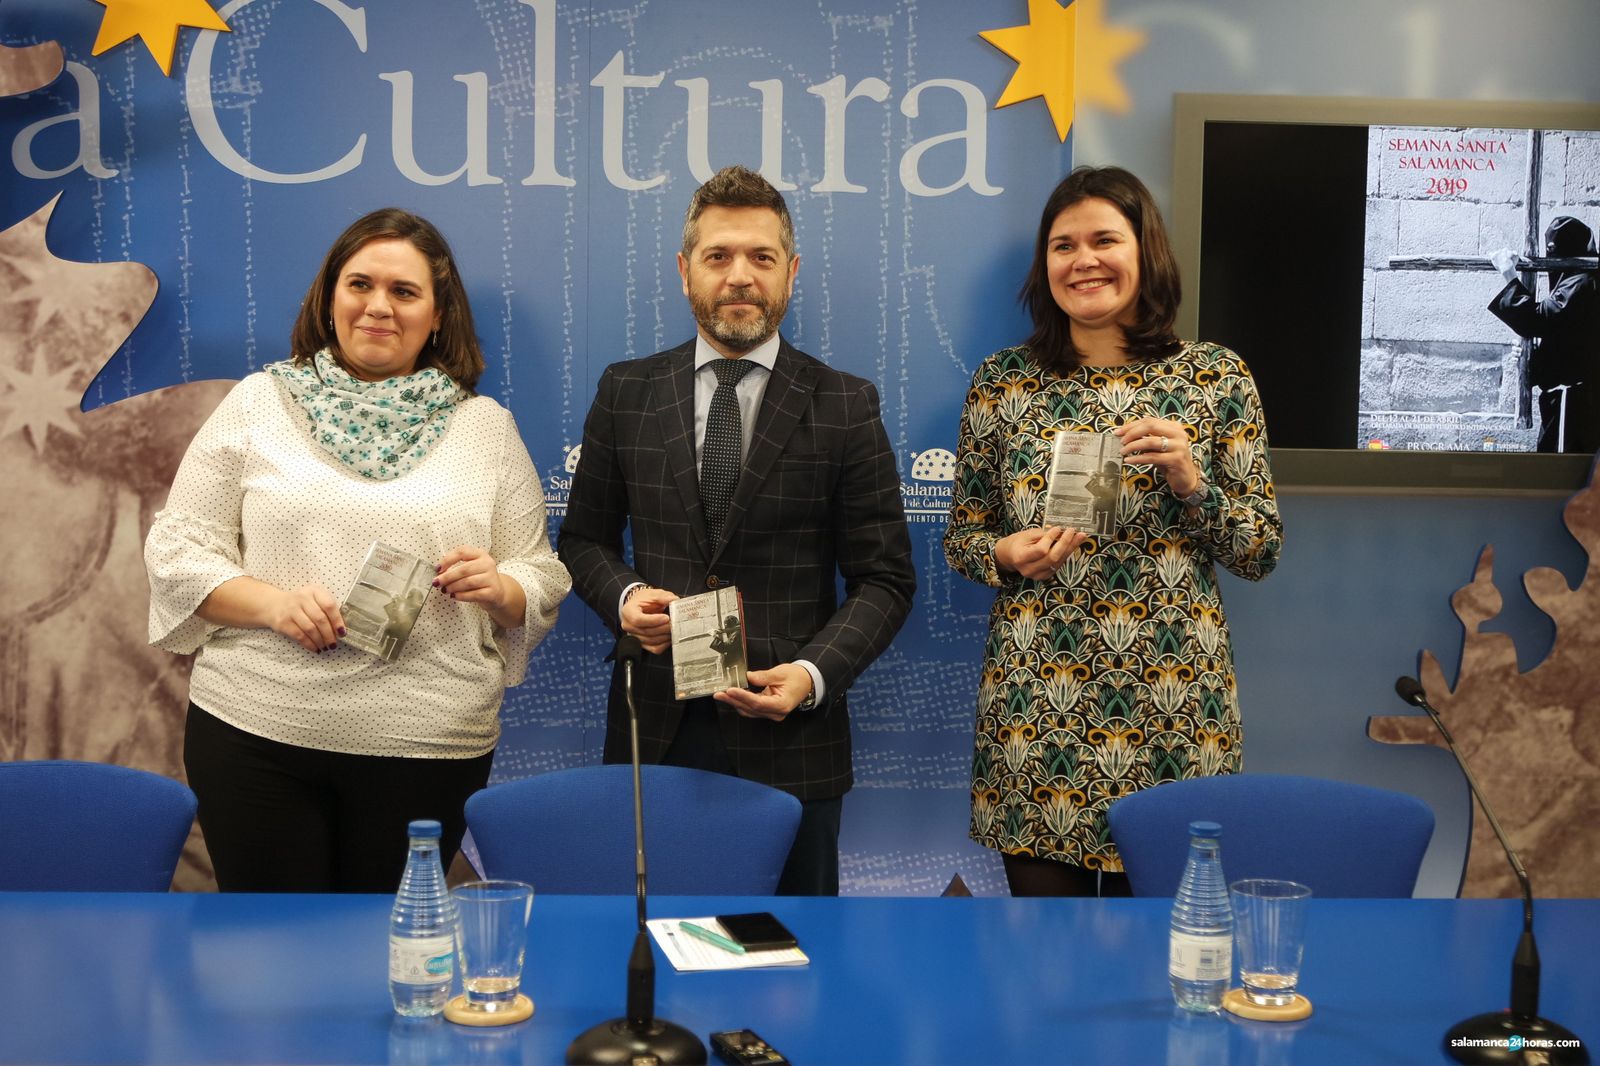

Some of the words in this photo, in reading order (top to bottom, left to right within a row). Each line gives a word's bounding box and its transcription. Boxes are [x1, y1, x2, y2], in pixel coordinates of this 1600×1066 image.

[186, 0, 1005, 197] Cultura
[1388, 138, 1451, 152] SEMANA
[1456, 140, 1508, 154] SANTA
[1398, 156, 1496, 171] SALAMANCA
[1425, 177, 1468, 195] 2019
[1371, 414, 1385, 422] DEL
[1407, 441, 1470, 451] PROGRAMA
[550, 476, 572, 490] Sal
[900, 482, 951, 497] Salama
[545, 492, 560, 501] dad
[922, 498, 952, 508] Cultur
[906, 515, 936, 523] MIENTO
